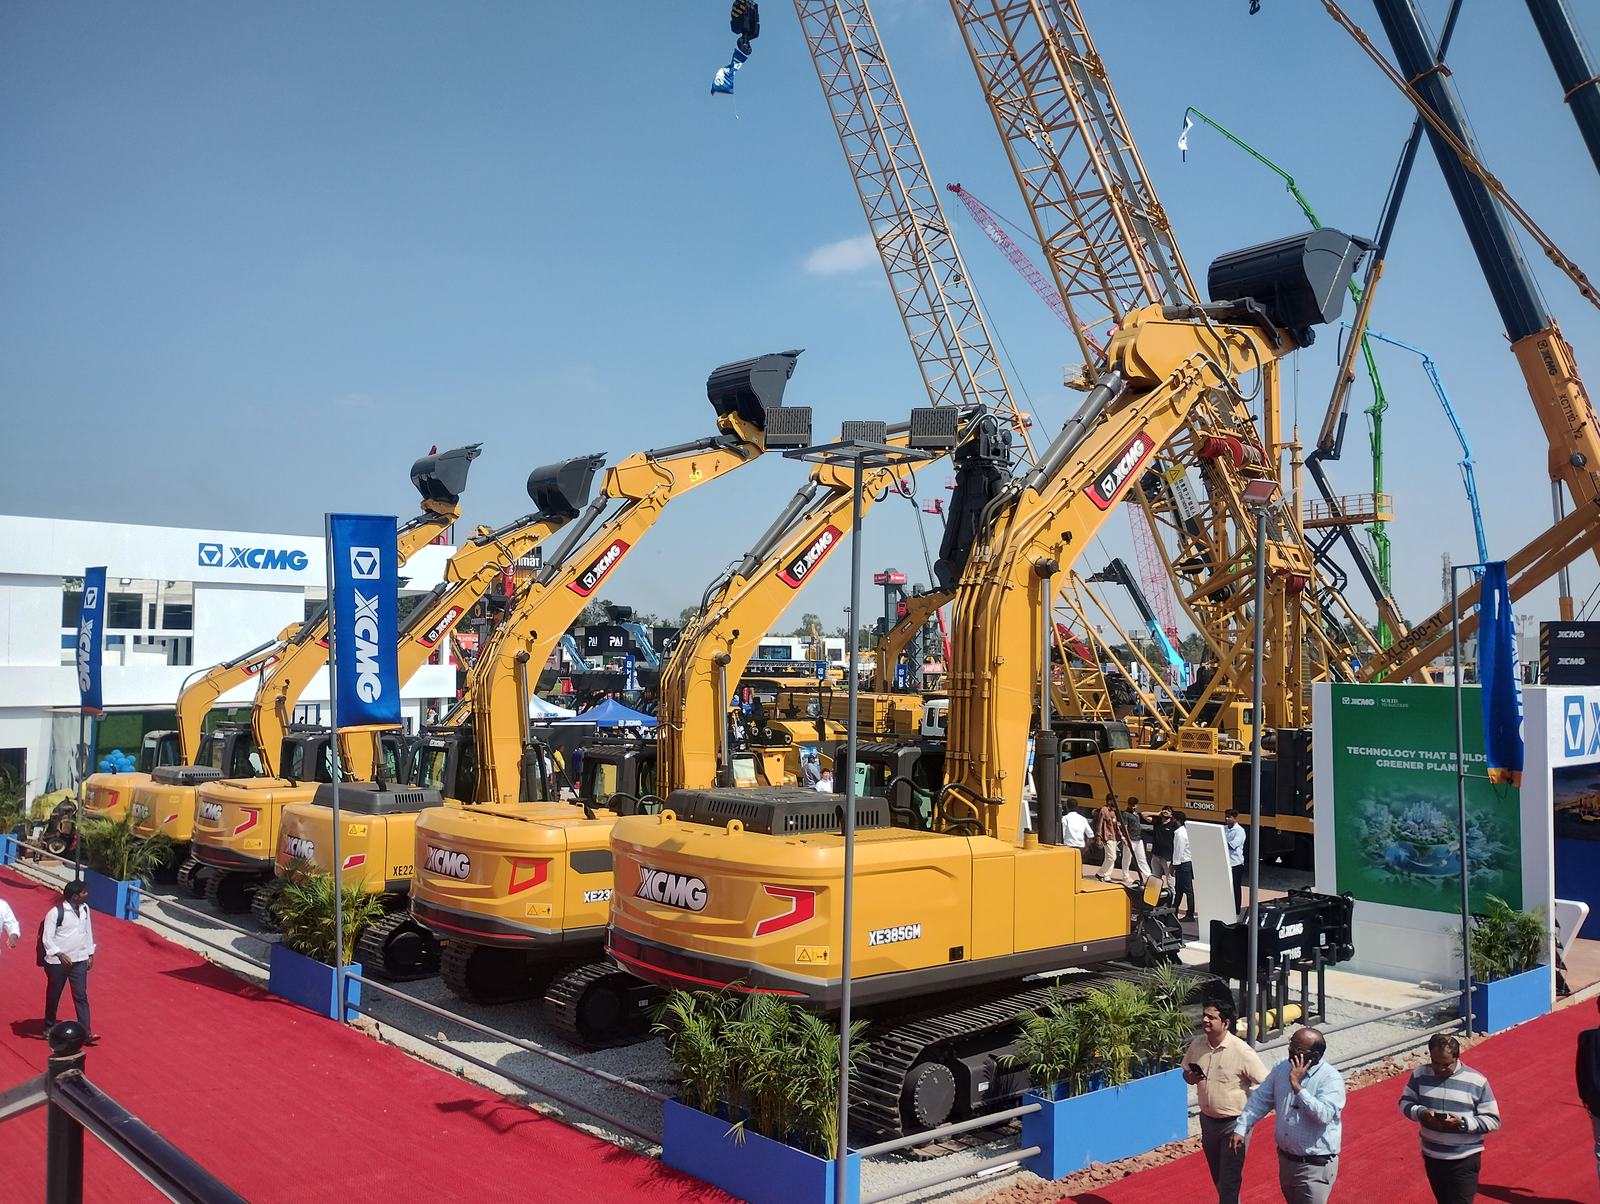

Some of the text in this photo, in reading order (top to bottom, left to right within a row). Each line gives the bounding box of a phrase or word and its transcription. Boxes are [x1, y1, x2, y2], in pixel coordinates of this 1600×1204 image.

[1542, 350, 1558, 376] XCMG
[1112, 439, 1145, 486] XCMG
[226, 546, 308, 572] XCMG
[592, 544, 621, 578] XCMG
[804, 531, 834, 569] XCMG
[438, 609, 457, 635] XCMG
[79, 615, 95, 693] XCMG
[354, 588, 382, 704] XCMG
[588, 636, 598, 647] PAI
[609, 636, 623, 647] PAI
[1351, 698, 1375, 706] XCMG
[1346, 746, 1415, 758] TECHNOLOGY
[1418, 751, 1446, 760] THAT
[1376, 759, 1424, 770] GREENER
[284, 835, 315, 860] XCMG
[424, 845, 471, 880] XCMG
[583, 889, 614, 903] XE23
[635, 867, 709, 912] XCMG
[867, 923, 922, 948] XE385GM
